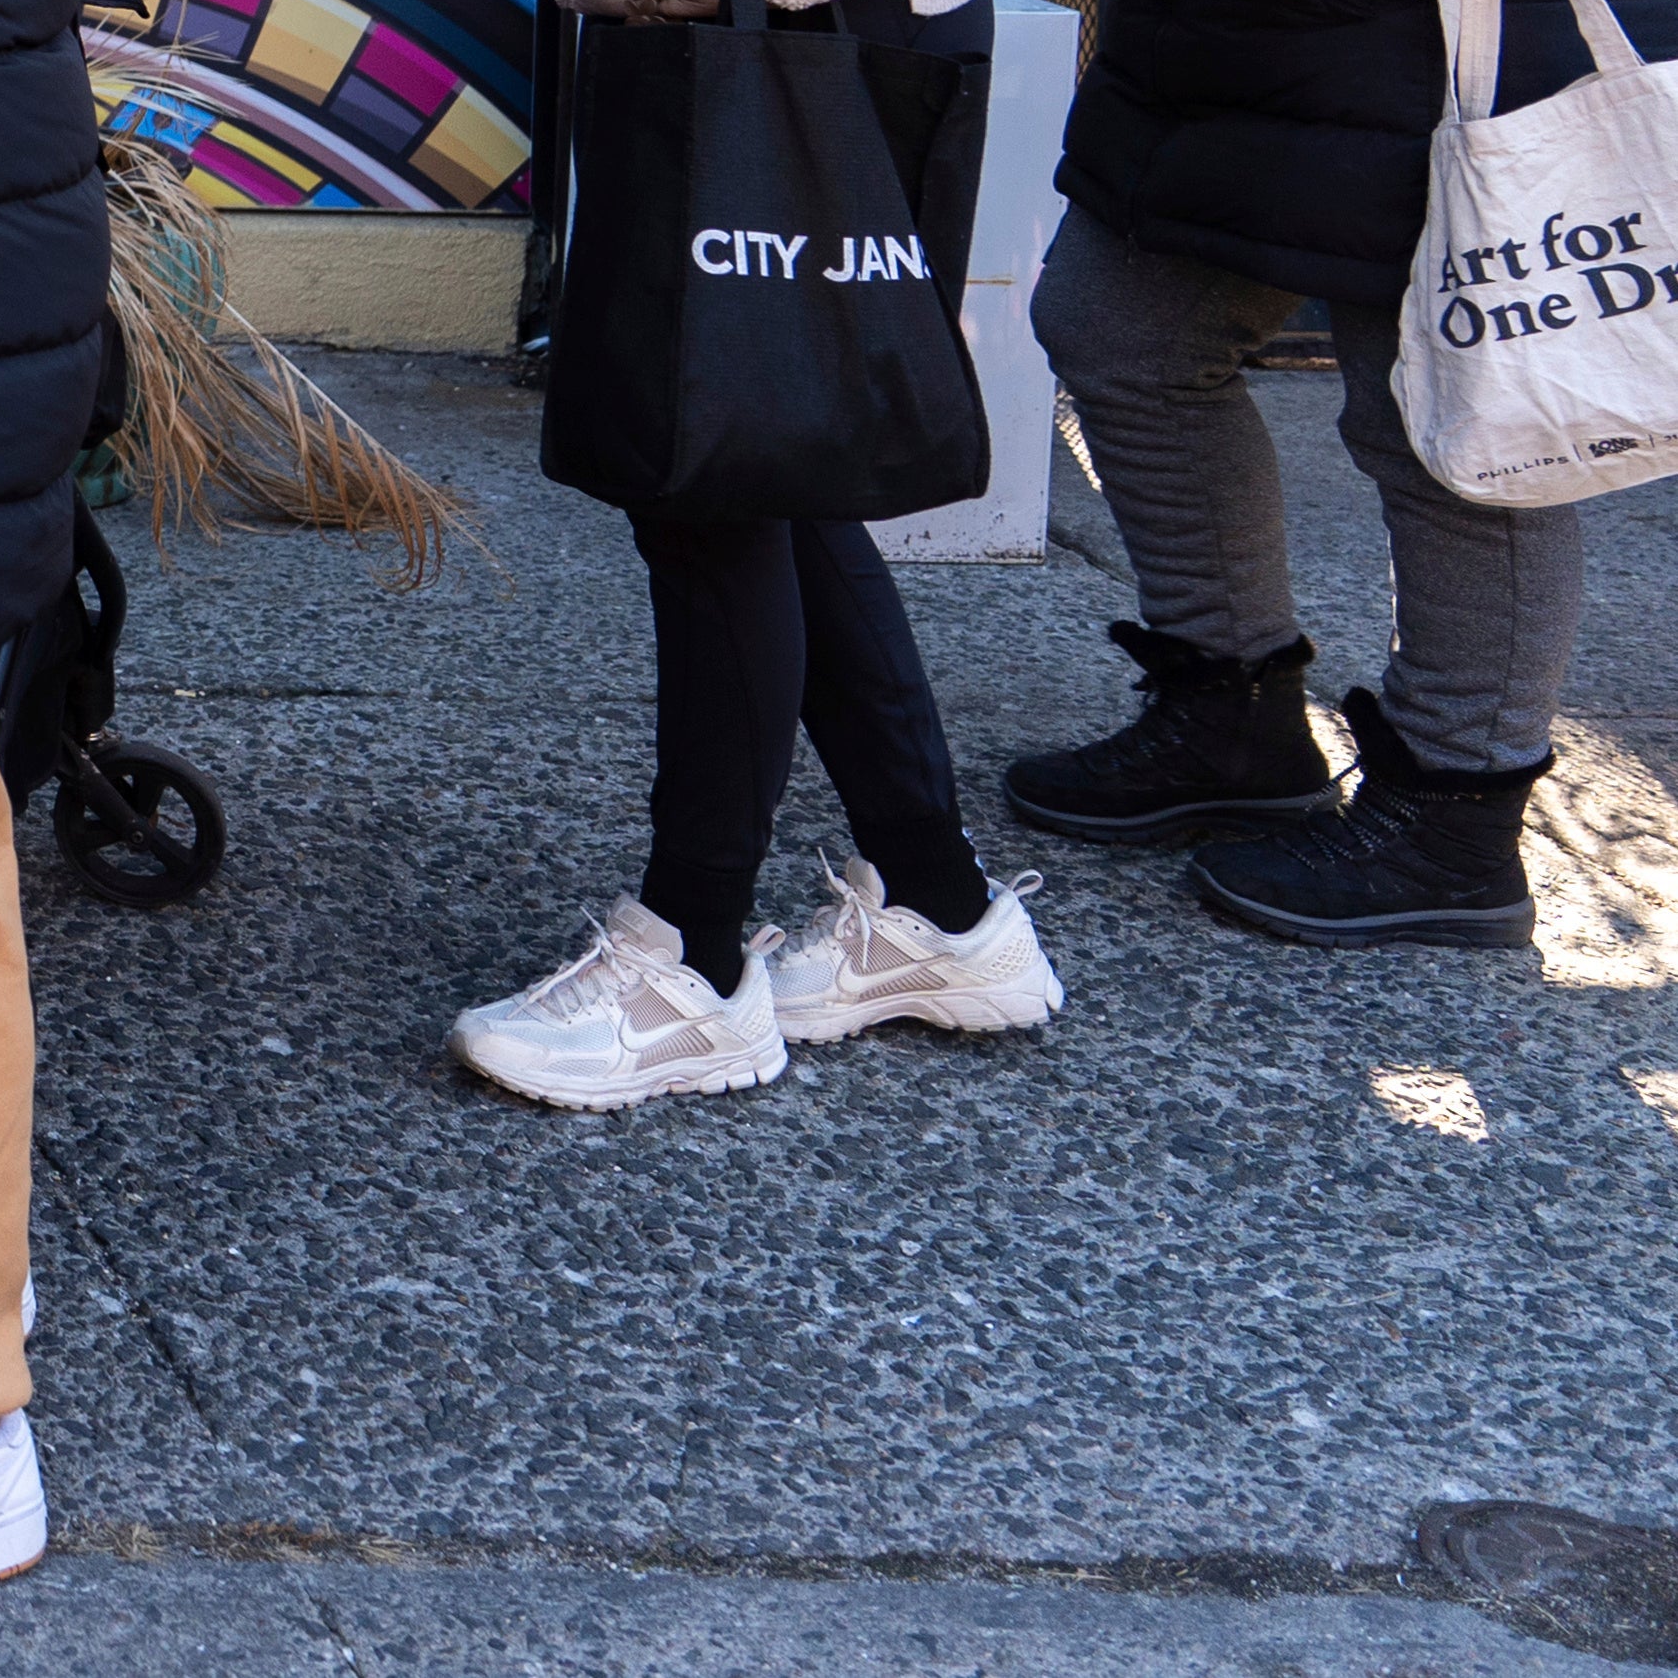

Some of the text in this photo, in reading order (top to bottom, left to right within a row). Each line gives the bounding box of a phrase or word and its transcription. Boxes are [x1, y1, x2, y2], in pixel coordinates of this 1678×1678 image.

[690, 228, 808, 280] CITY
[1438, 211, 1648, 294] Art for
[1440, 292, 1578, 350] One
[1477, 455, 1570, 481] PHILLIPS
